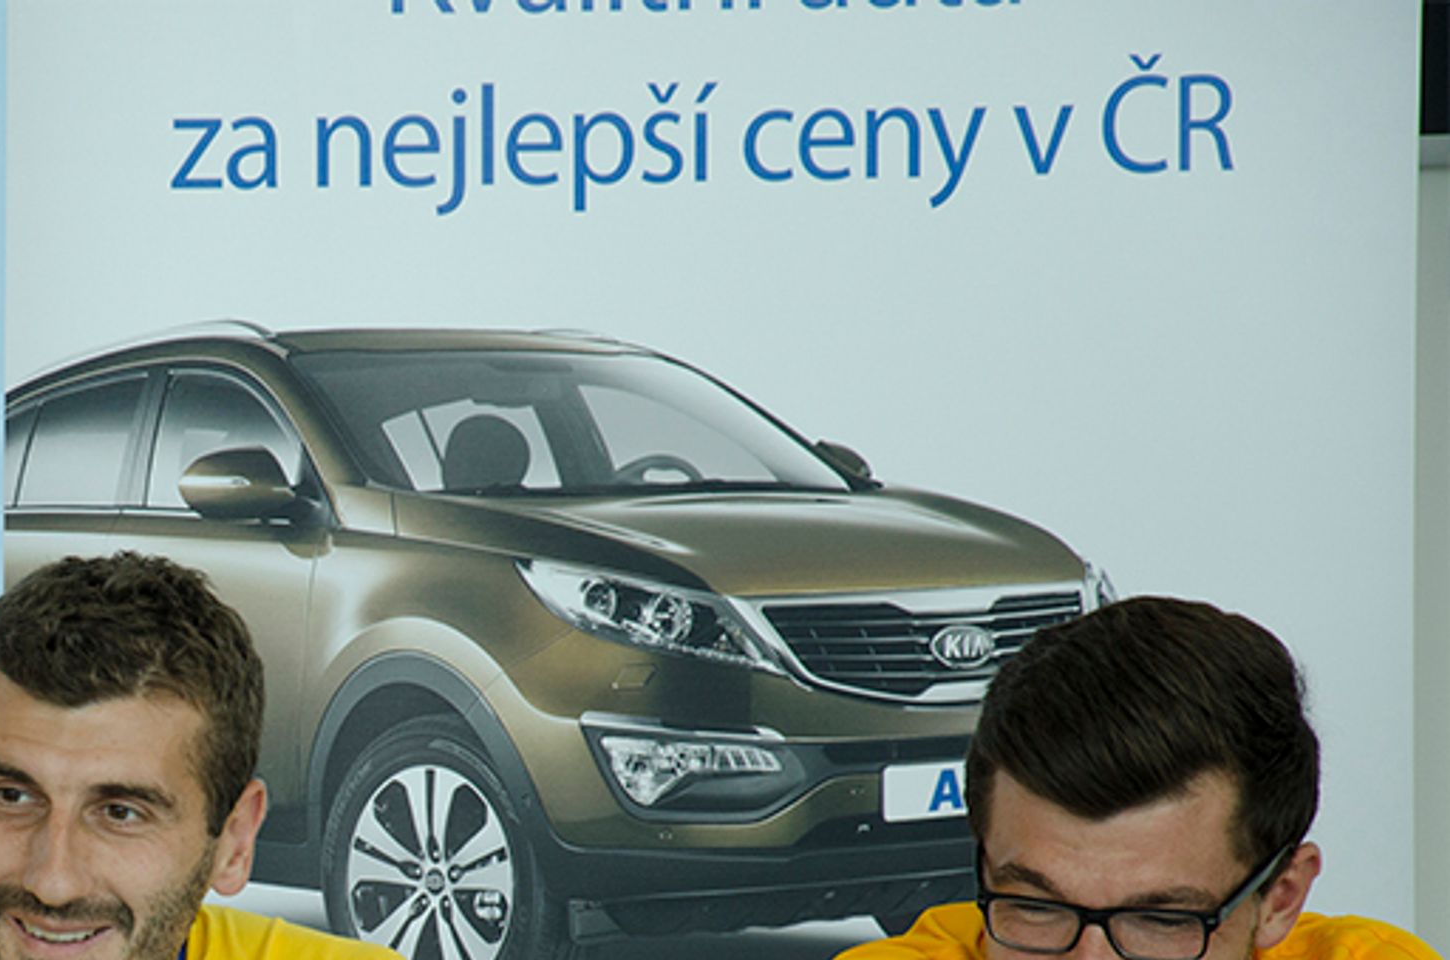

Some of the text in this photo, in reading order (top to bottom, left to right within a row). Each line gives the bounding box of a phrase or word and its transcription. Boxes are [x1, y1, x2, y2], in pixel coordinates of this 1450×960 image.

[170, 53, 1234, 216] za nejlepší ceny v ČR
[943, 631, 988, 659] KIA
